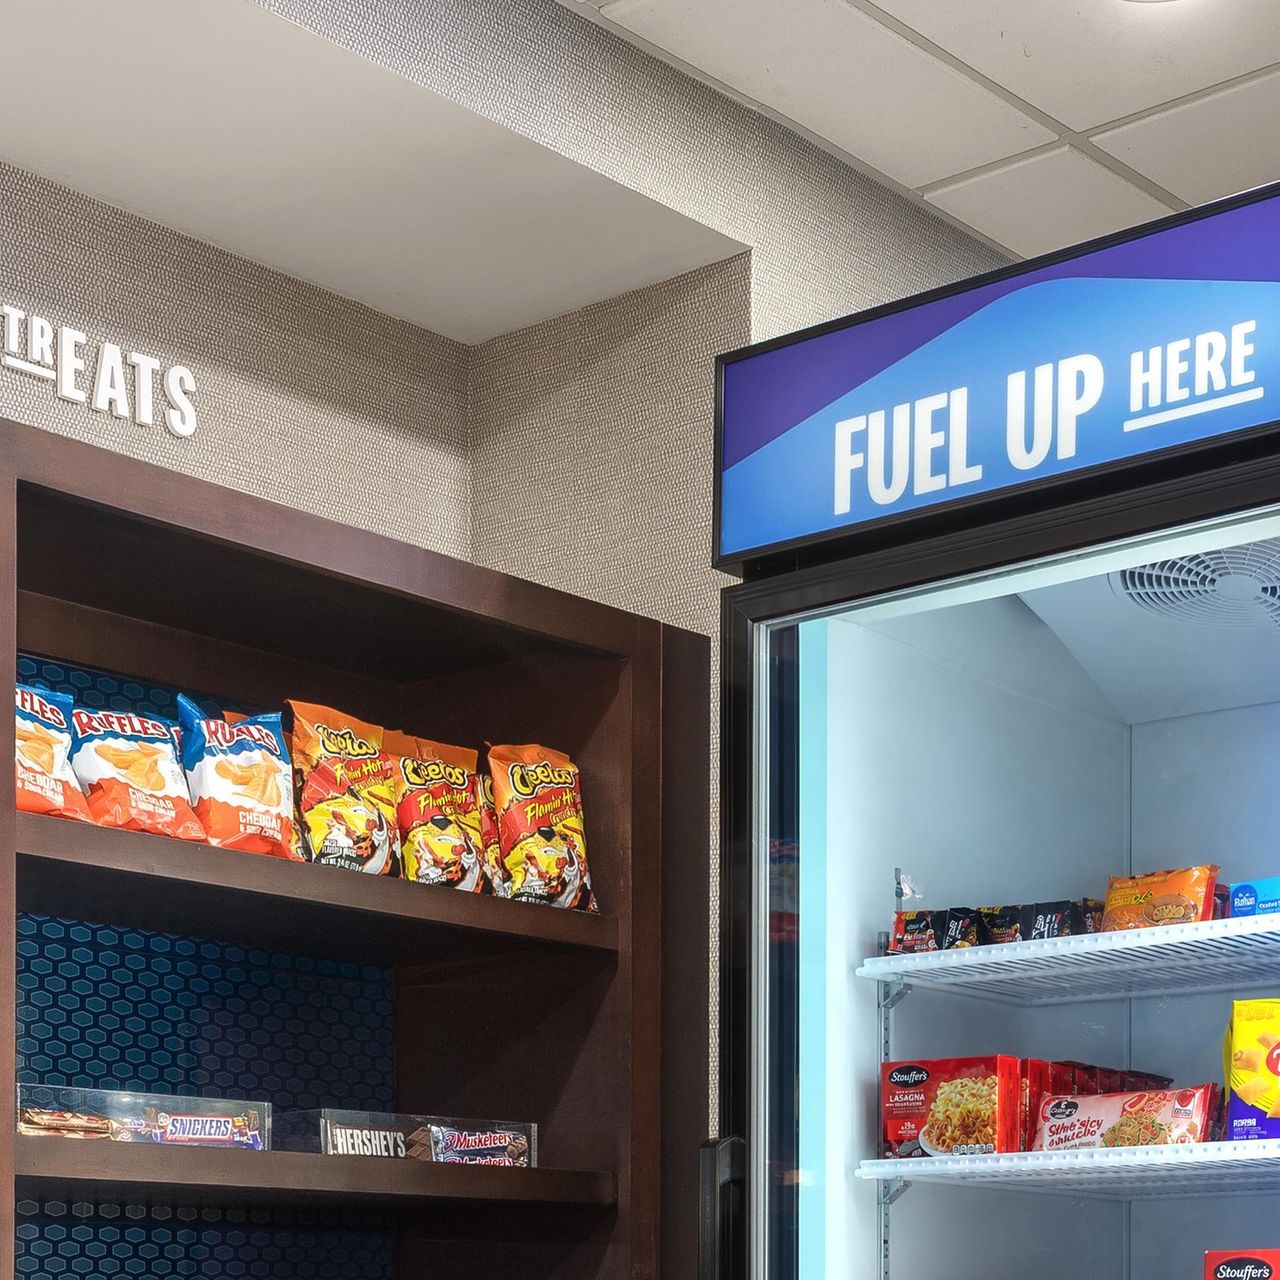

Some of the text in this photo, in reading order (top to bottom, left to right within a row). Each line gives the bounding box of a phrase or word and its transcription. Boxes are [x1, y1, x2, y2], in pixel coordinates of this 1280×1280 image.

[0, 303, 197, 438] TREATS
[834, 320, 1255, 515] FUEL UP HERE
[73, 709, 169, 738] RUFFLES
[890, 1071, 928, 1084] Stouffer's
[890, 1094, 925, 1102] LASAGNA
[170, 1118, 231, 1138] SNICKERS
[337, 1129, 406, 1157] HERSHEY'S
[442, 1131, 455, 1150] 3
[1217, 1265, 1270, 1280] Stouffer's
